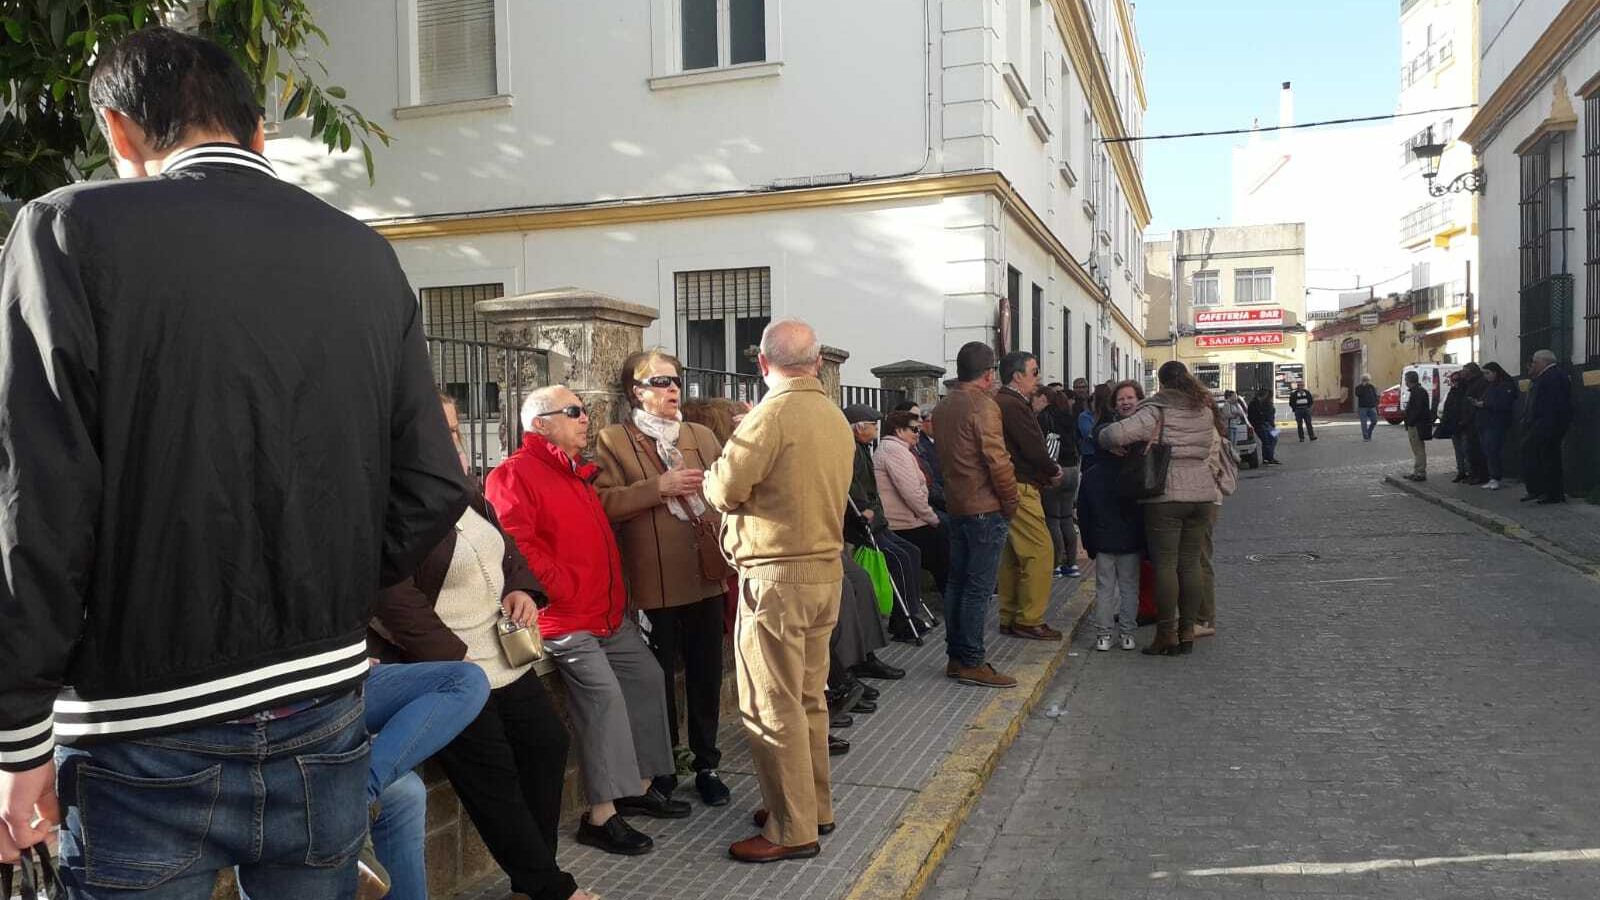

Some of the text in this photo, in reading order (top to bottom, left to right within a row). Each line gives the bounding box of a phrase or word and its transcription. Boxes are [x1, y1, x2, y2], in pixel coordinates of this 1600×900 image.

[1259, 310, 1279, 318] BAR
[1209, 334, 1280, 345] SANCHO PANZA
